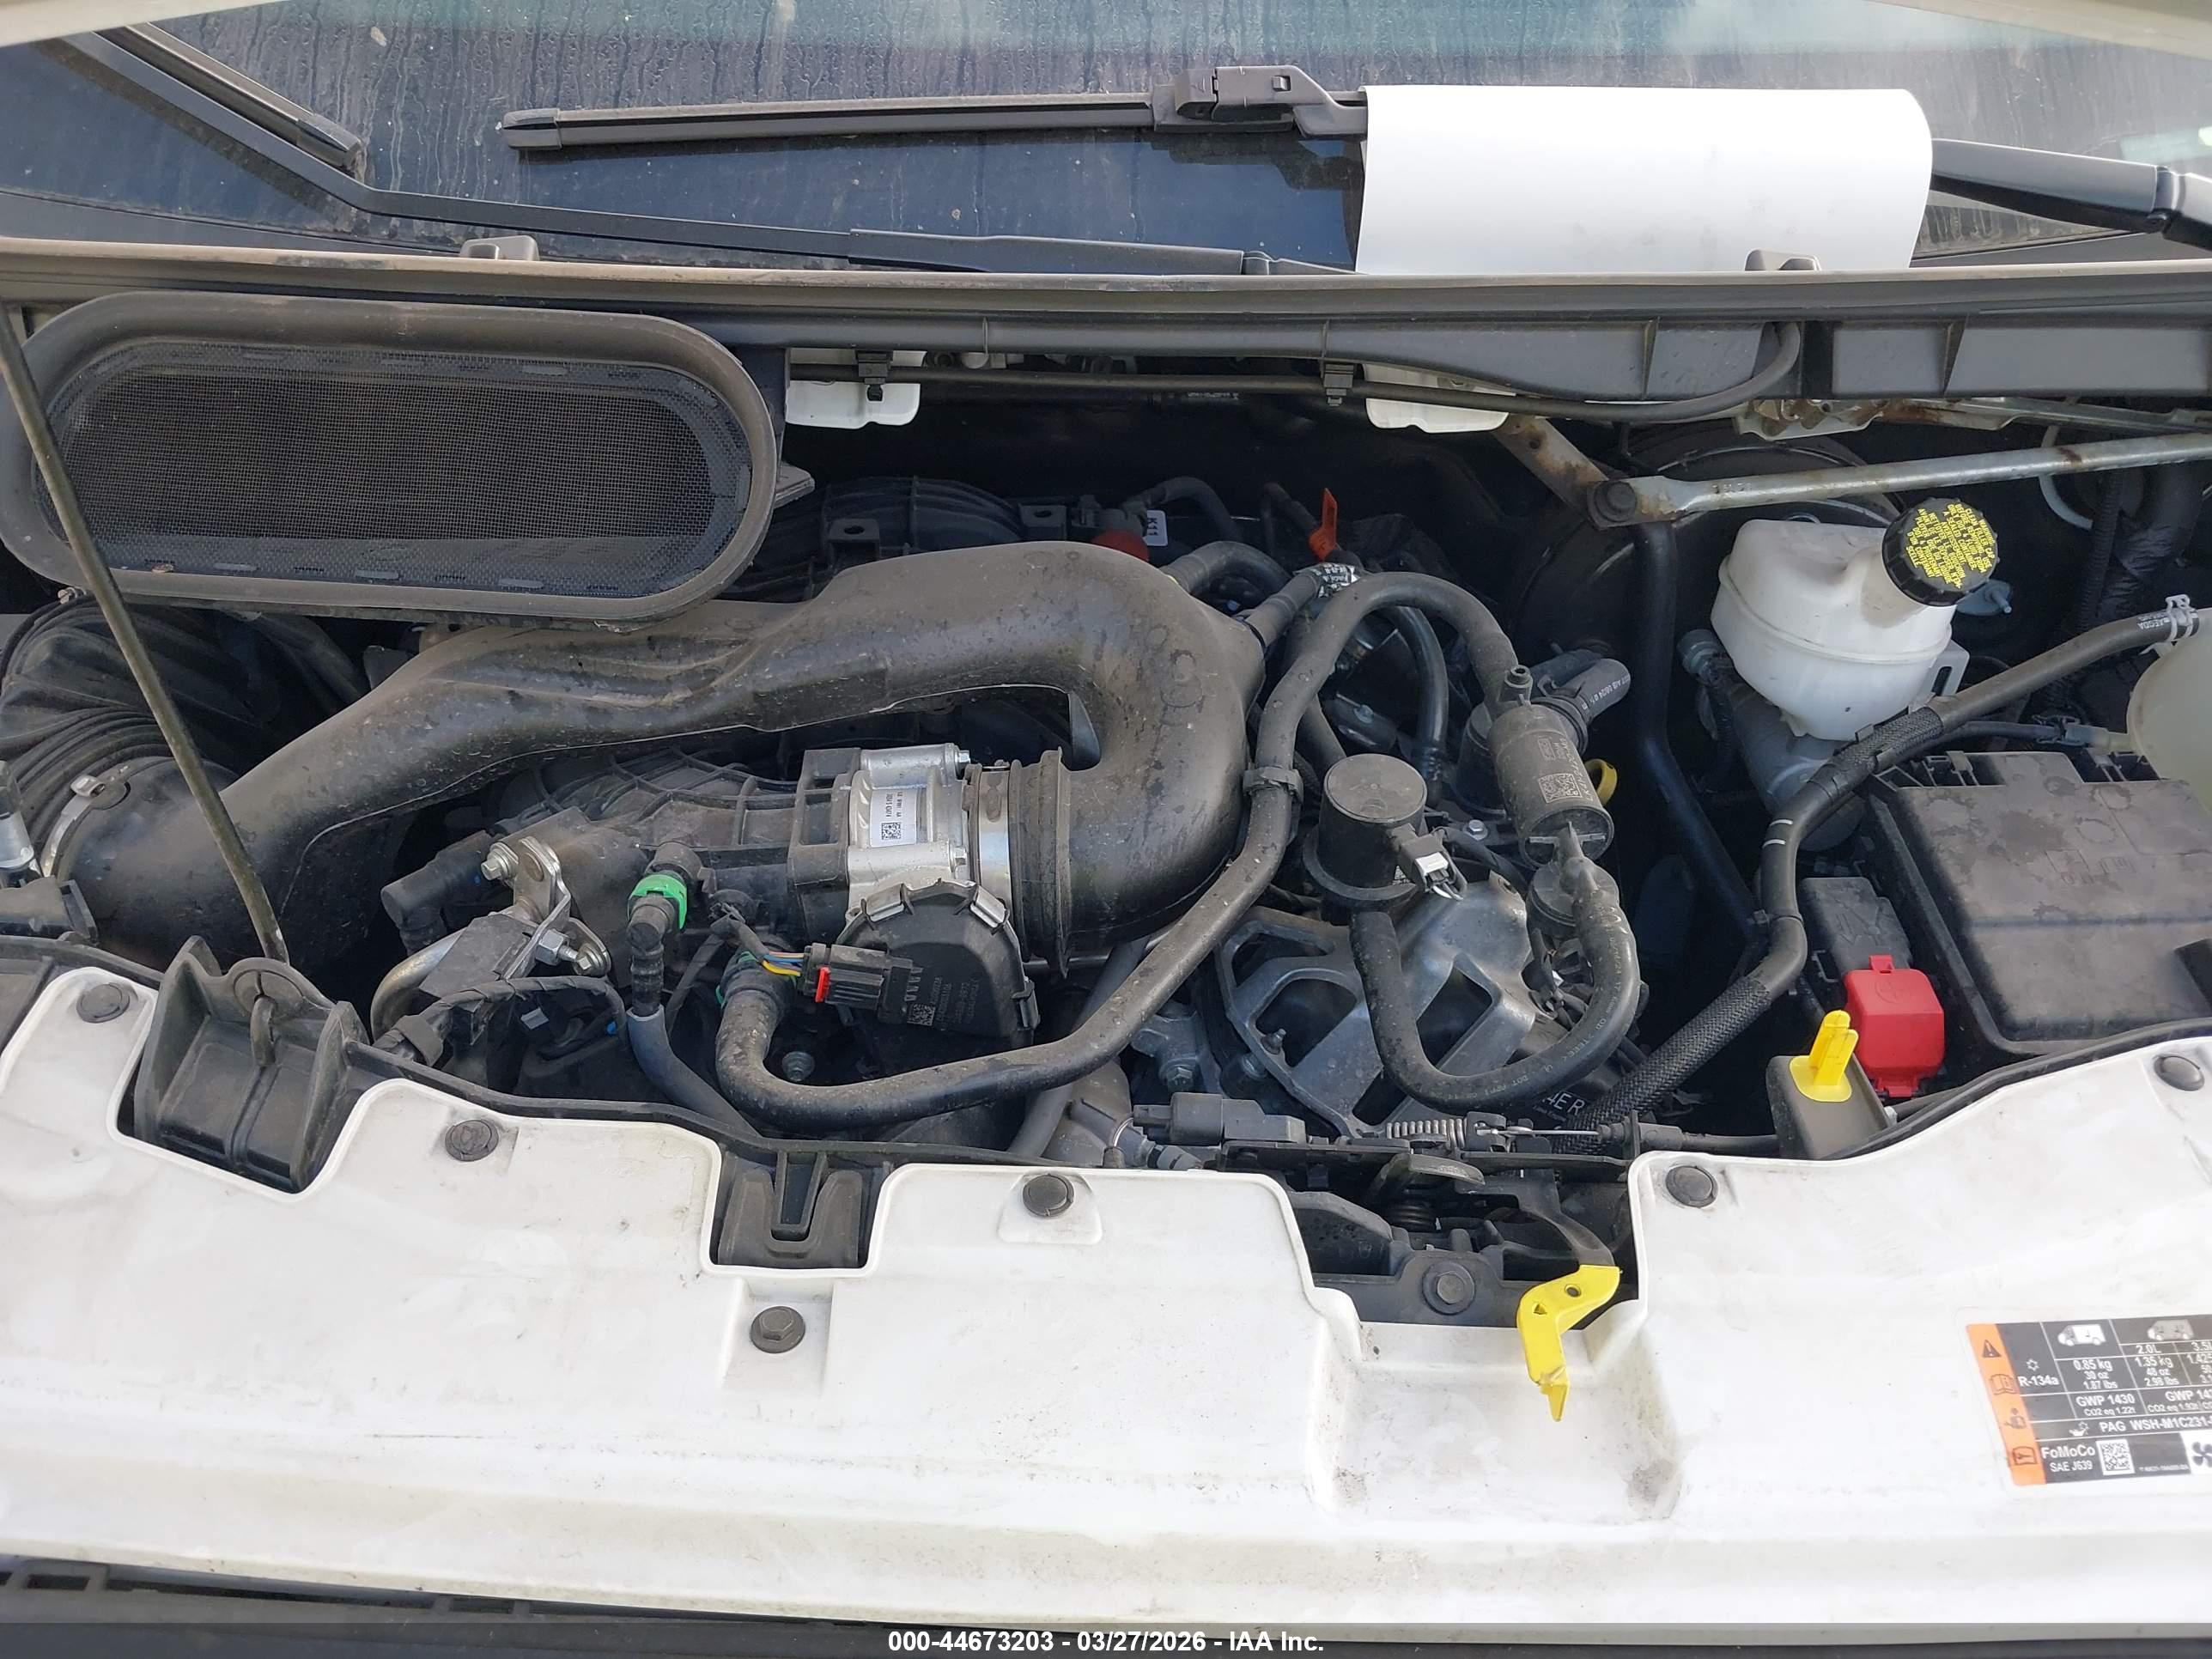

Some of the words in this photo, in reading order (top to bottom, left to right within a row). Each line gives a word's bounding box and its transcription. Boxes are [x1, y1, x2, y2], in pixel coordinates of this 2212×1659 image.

[1917, 508, 1933, 526] AVANT
[1928, 513, 1948, 540] NETTOYER
[1946, 517, 1962, 538] SEALED
[1965, 508, 1978, 526] CLEAN
[1974, 527, 1989, 546] FILLER
[1984, 547, 1996, 559] CAP
[1948, 504, 1960, 519] ONLY
[1955, 520, 1966, 531] DOT
[1966, 538, 1978, 555] FLUID
[1973, 556, 1987, 574] FROM
[1954, 503, 1971, 526] BEFORE
[1981, 556, 1992, 568] USE
[1912, 526, 1923, 538] DOT
[1921, 545, 1944, 577] PROVENANT
[1913, 546, 1936, 577] CONTENANT
[1926, 538, 1938, 551] QUE
[1936, 561, 1954, 584] LIQUIDE
[2136, 1344, 2161, 1354] 2.0L
[2073, 1359, 2097, 1370] 0.85
[2096, 1358, 2113, 1371] kg
[2135, 1356, 2157, 1367] 1.35
[2157, 1355, 2174, 1368] kg
[2017, 1375, 2060, 1387] R-134a
[2102, 1380, 2118, 1389] lbs
[2164, 1376, 2179, 1385] lbs
[2075, 1395, 2105, 1407] GWP
[2107, 1393, 2136, 1406] 1430
[2165, 1390, 2193, 1401] GWP
[2148, 1404, 2166, 1413] CO2
[2100, 1421, 2126, 1432] PAG
[2130, 1417, 2212, 1431] WSH-M1C231-
[2040, 1444, 2096, 1459] FoMoCo
[2050, 1461, 2069, 1472] SAE
[2071, 1460, 2093, 1471] J639
